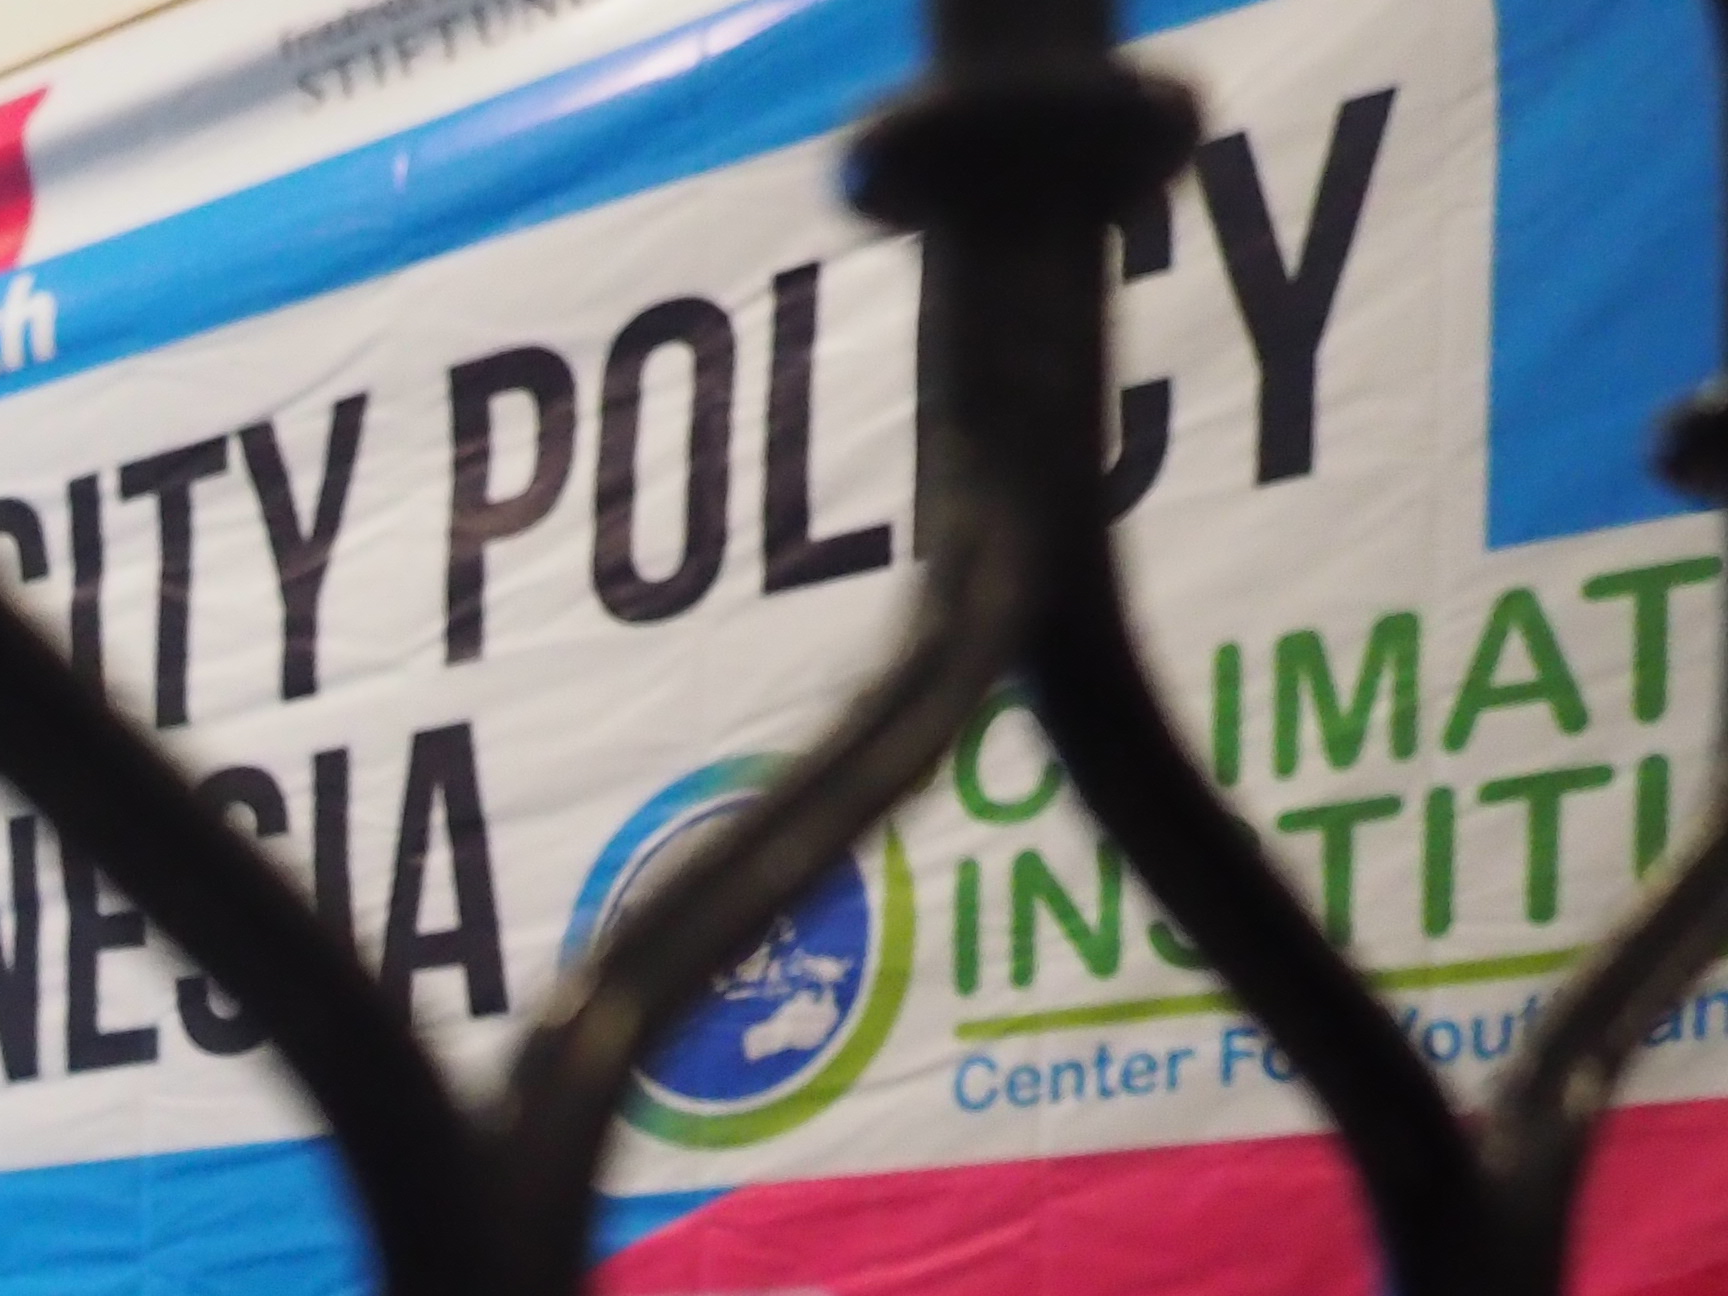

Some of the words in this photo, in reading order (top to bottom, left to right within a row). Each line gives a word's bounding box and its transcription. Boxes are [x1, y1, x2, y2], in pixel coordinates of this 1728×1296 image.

[952, 556, 1724, 825] CIMAT
[953, 1044, 1196, 1112] Center
[1218, 1025, 1302, 1086] Fo
